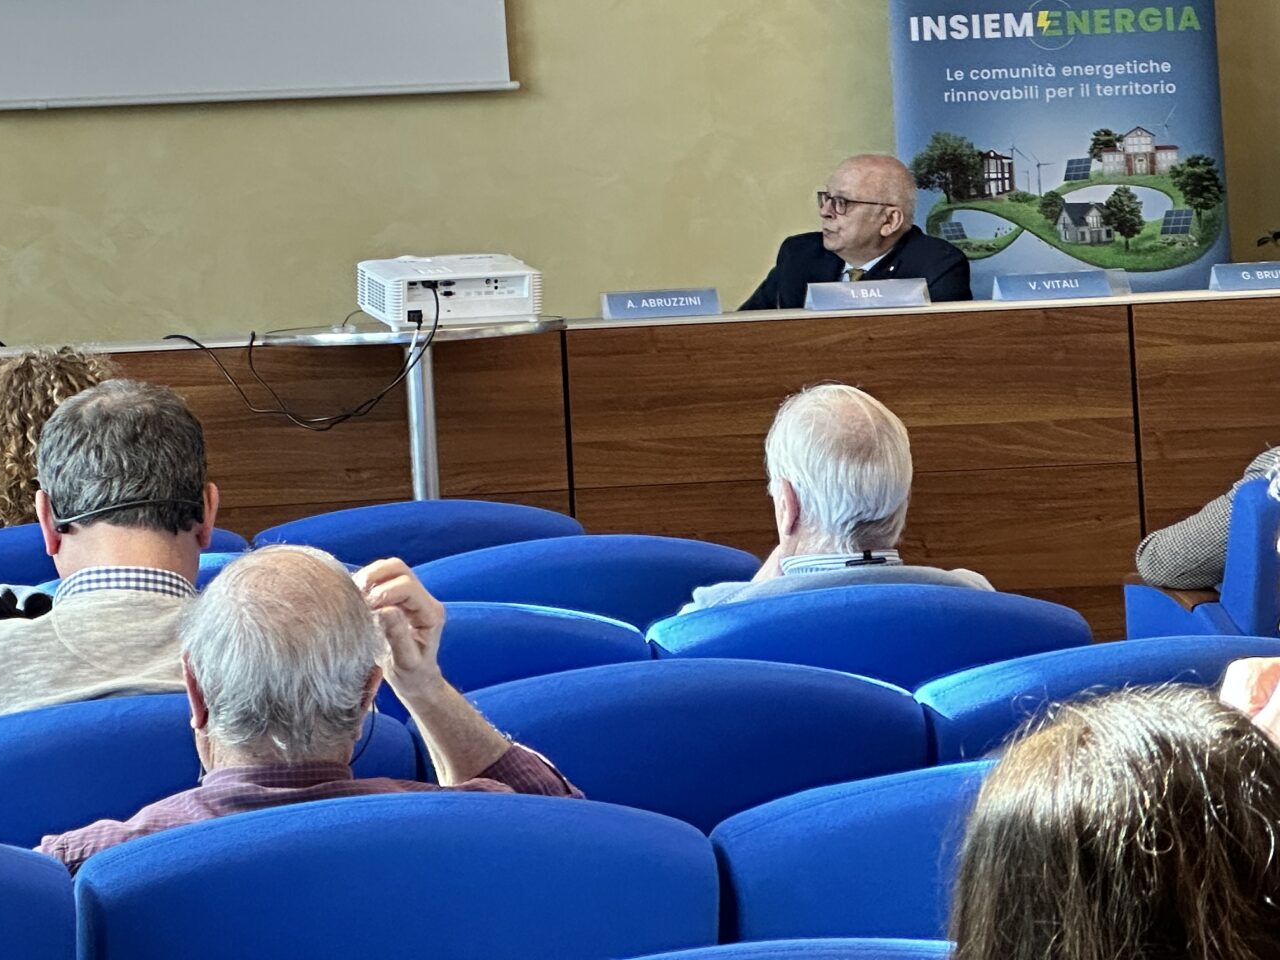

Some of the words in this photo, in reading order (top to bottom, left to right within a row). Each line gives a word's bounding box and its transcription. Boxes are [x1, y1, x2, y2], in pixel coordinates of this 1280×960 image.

[946, 68, 965, 81] Le
[970, 63, 1056, 81] comunità
[1061, 59, 1172, 80] energetiche
[944, 85, 1039, 103] rinnovabili
[1045, 86, 1074, 104] per
[1080, 83, 1090, 97] il
[1096, 80, 1177, 97] territorio
[1241, 271, 1255, 280] G.
[1256, 270, 1280, 280] BRU
[1028, 281, 1041, 291] V.
[1043, 279, 1079, 290] VITALI
[860, 288, 884, 298] BAL
[626, 299, 639, 309] A.
[641, 296, 701, 309] ABRUZZINI
